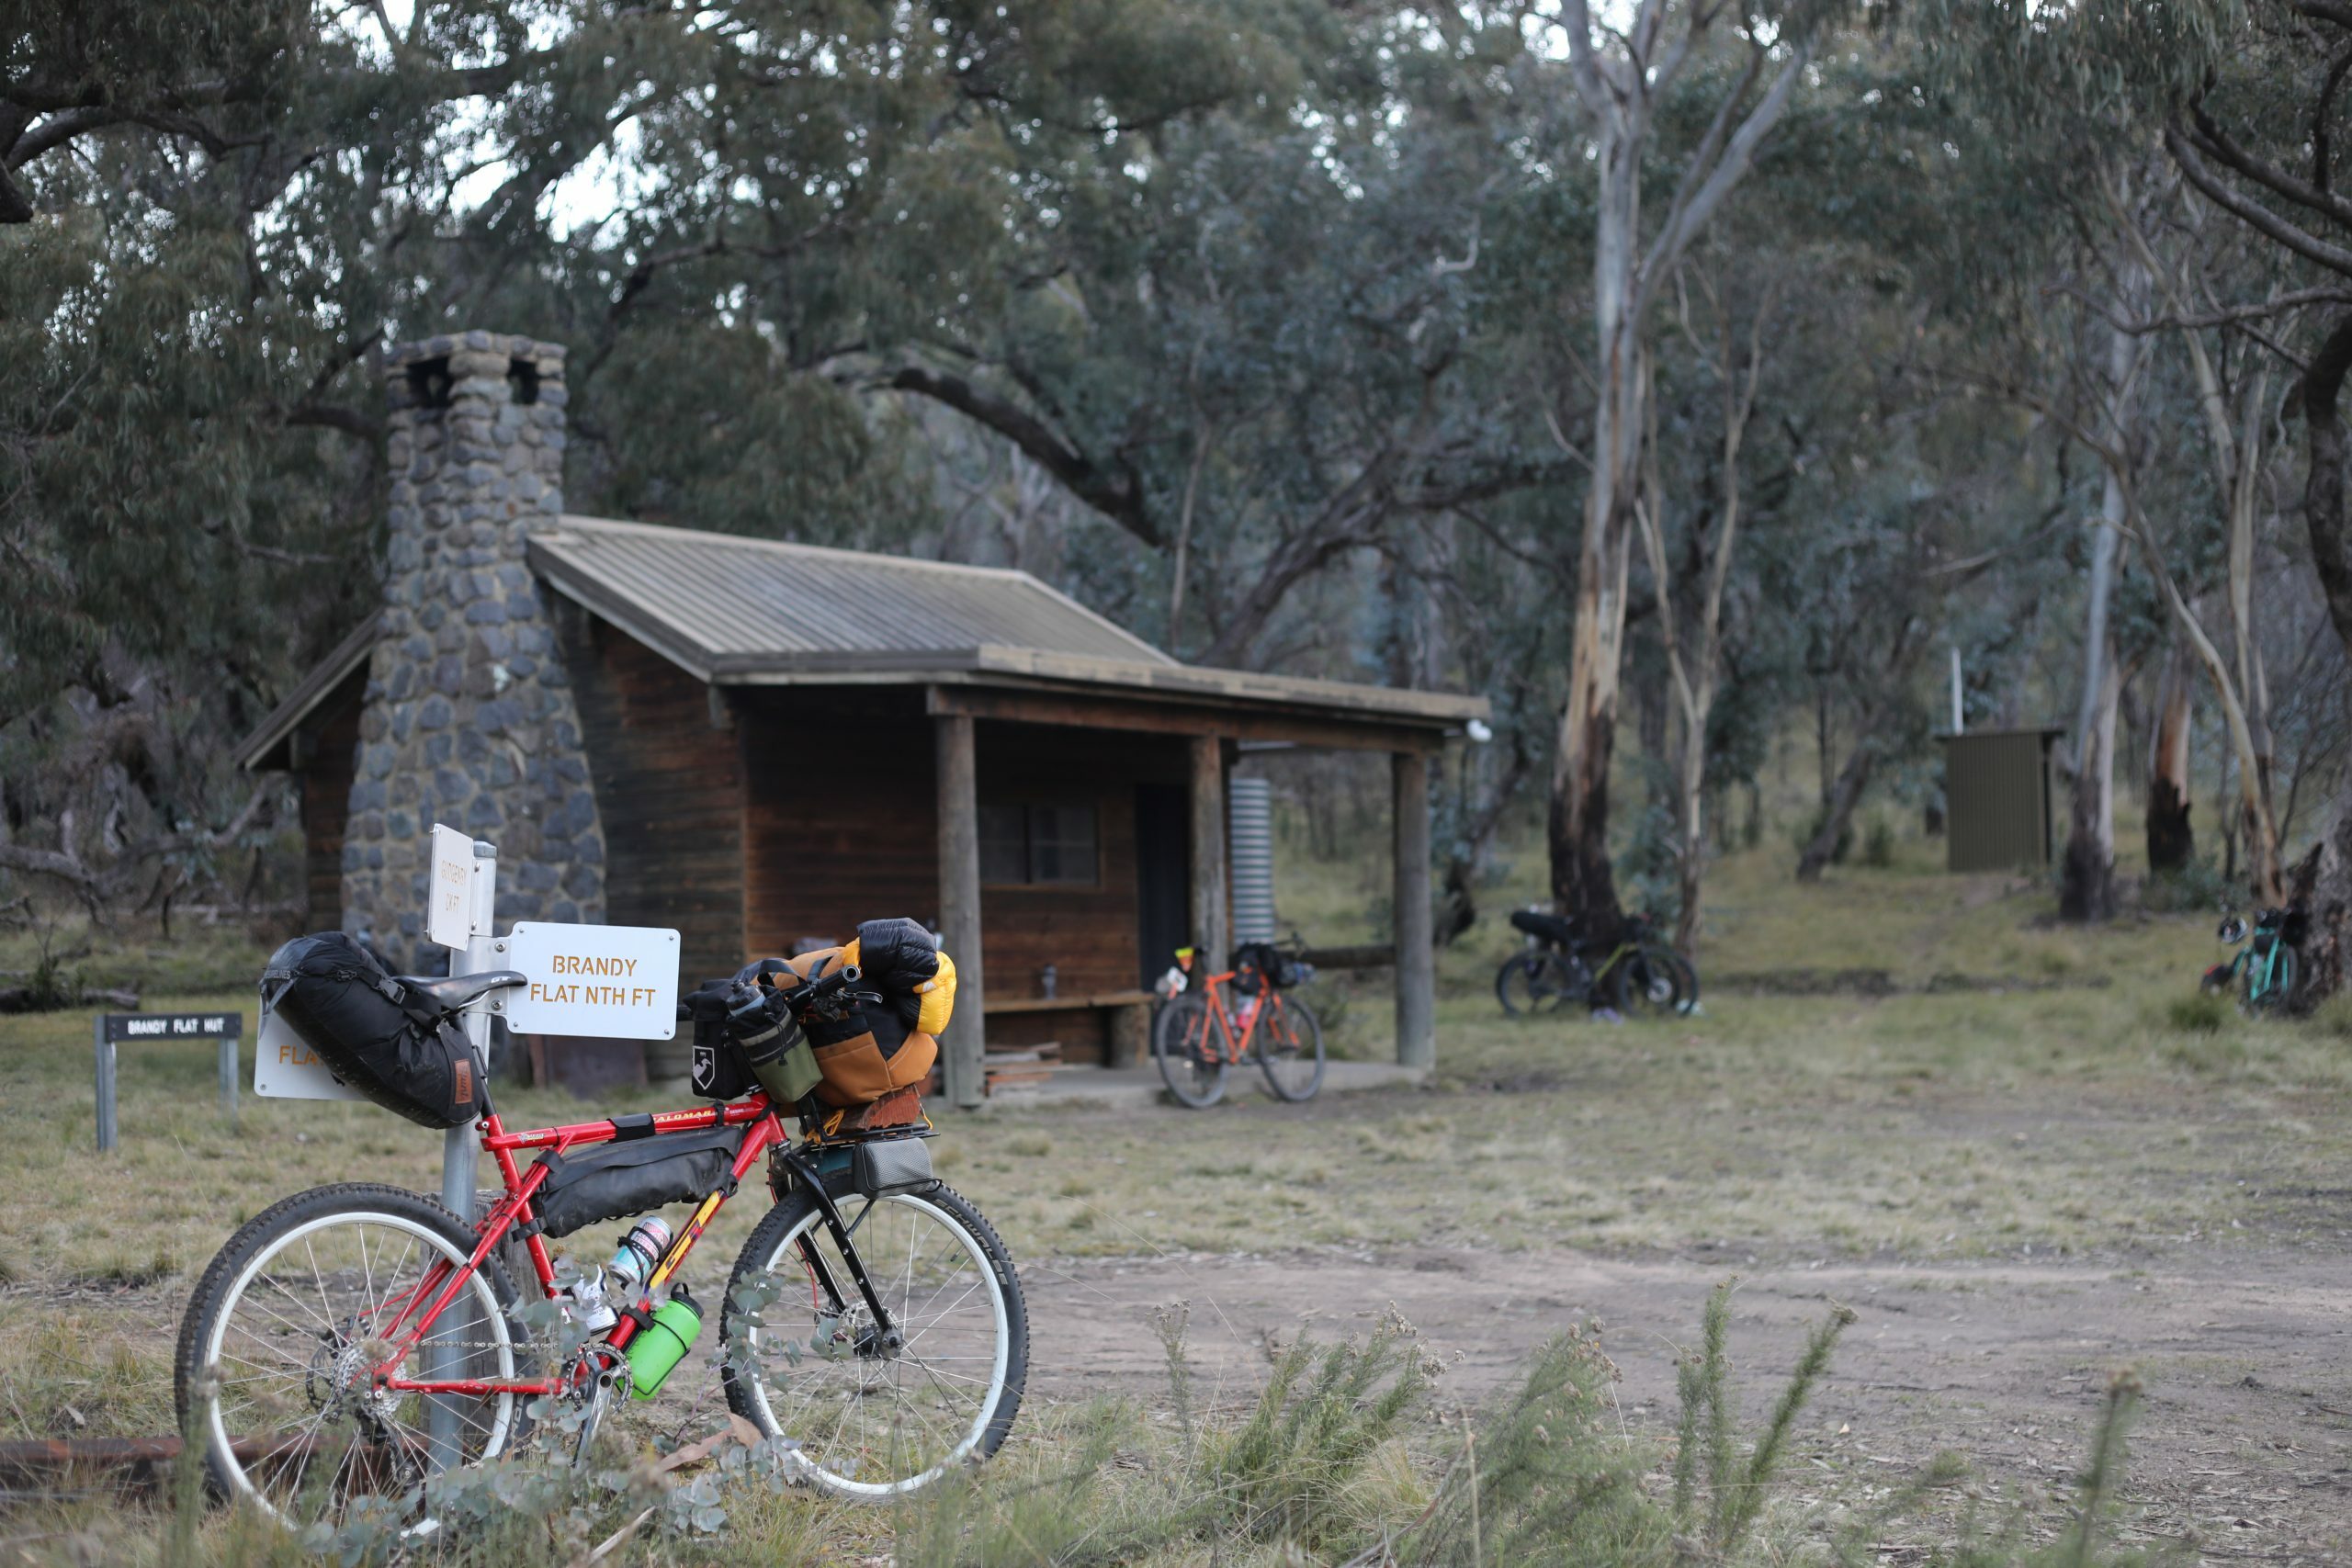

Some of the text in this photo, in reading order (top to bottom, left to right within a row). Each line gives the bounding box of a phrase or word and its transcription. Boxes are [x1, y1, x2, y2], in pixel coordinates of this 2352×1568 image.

[552, 954, 638, 976] BRANDY
[530, 983, 656, 1007] FLAT NTH FT
[127, 1017, 225, 1035] BRANDY FLAT HUT
[278, 1045, 325, 1066] FLA
[933, 1199, 1009, 1285] SCHWALBE
